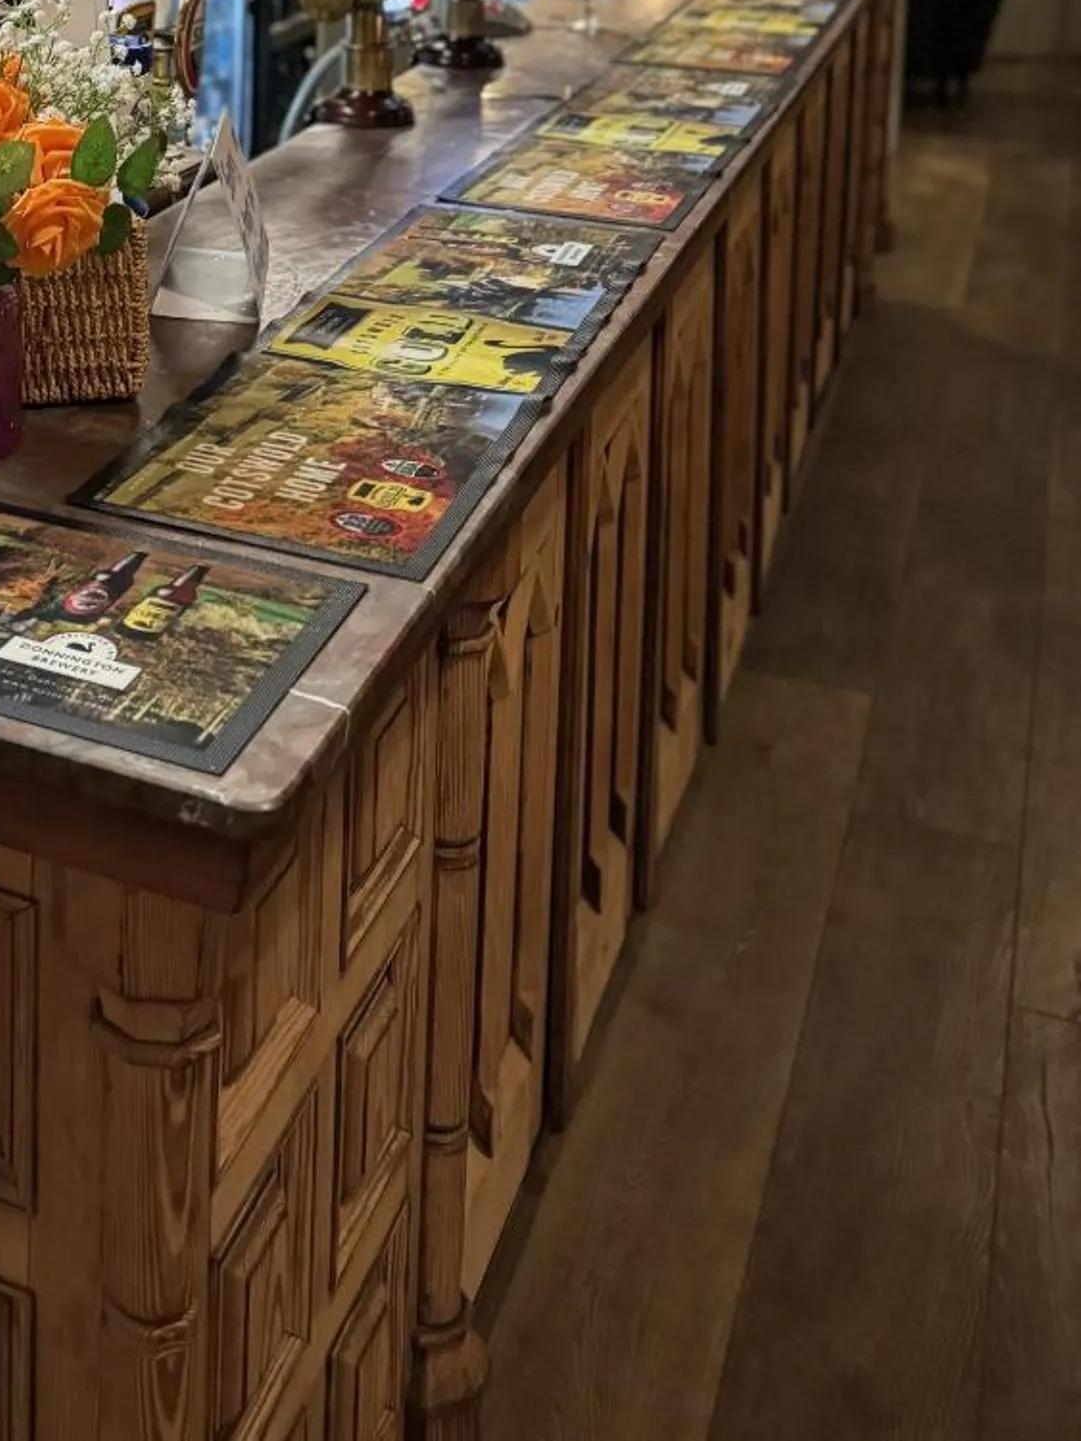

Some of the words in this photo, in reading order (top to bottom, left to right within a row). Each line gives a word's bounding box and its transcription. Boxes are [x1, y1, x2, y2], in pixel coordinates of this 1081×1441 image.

[175, 442, 237, 475] OUR
[202, 431, 308, 510] COTSWOLD
[274, 456, 348, 503] HOME
[20, 641, 125, 675] DONNINGTON
[31, 654, 98, 676] BREWERY
